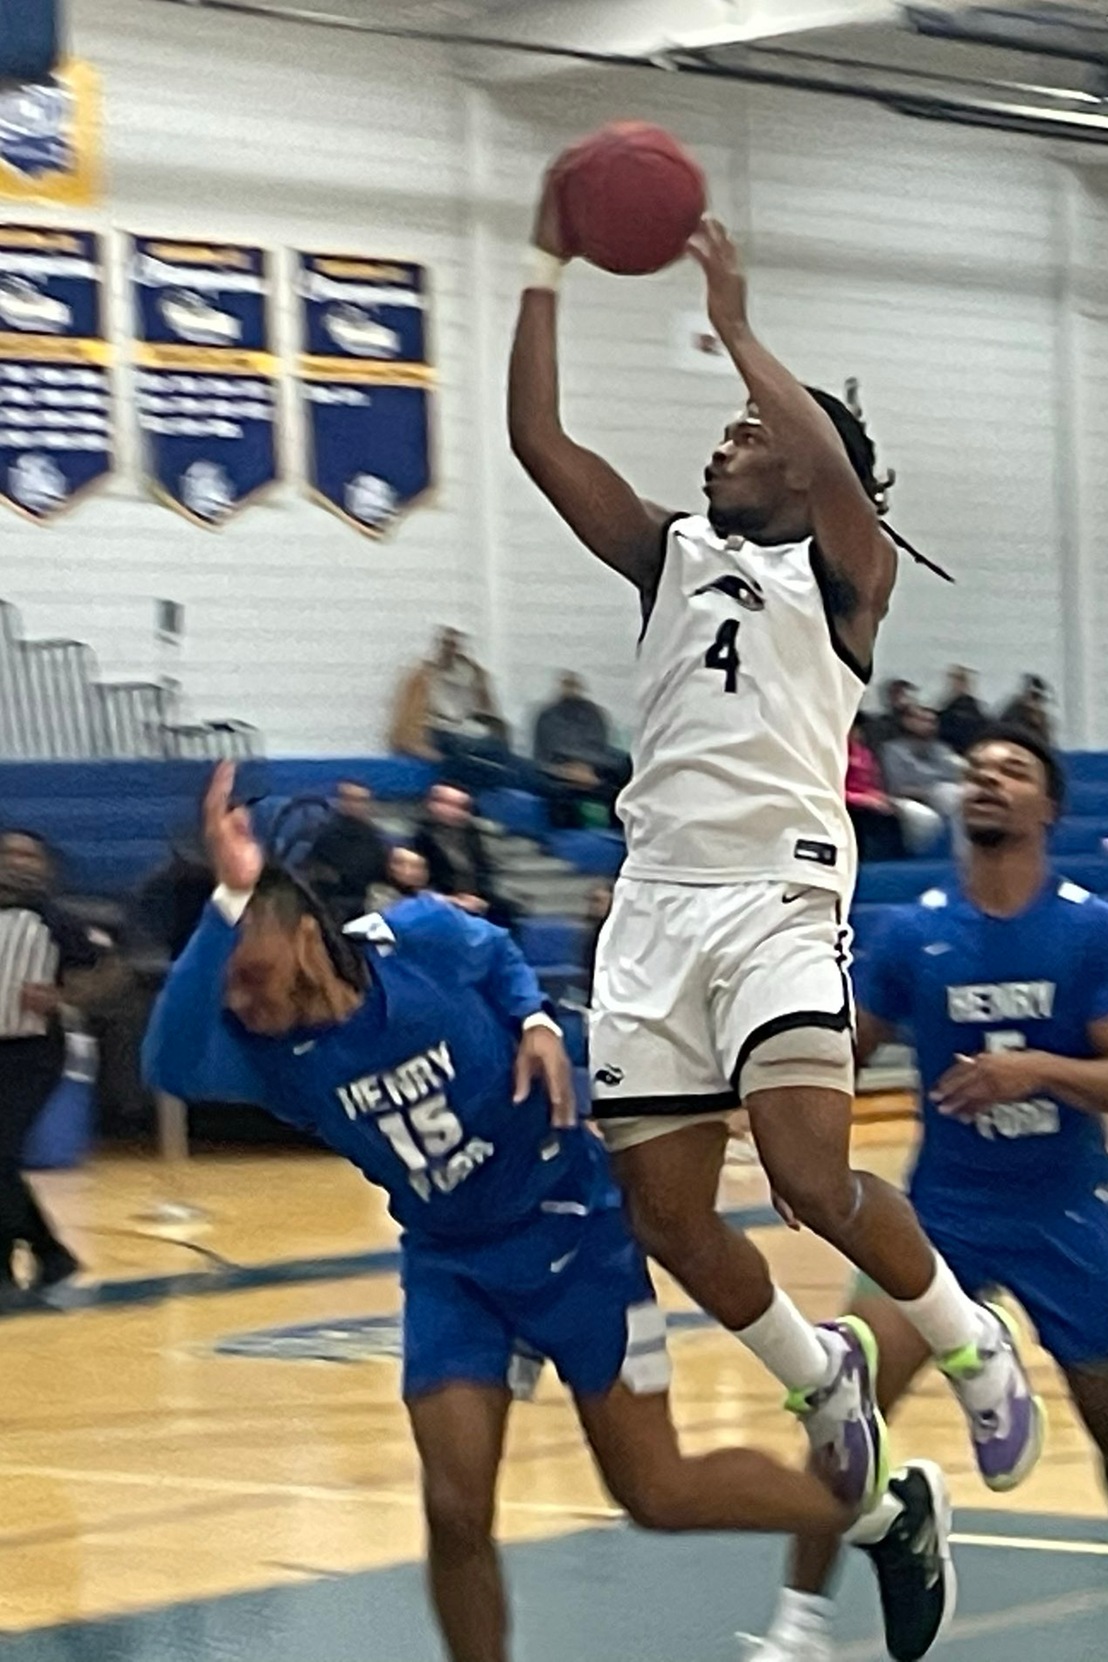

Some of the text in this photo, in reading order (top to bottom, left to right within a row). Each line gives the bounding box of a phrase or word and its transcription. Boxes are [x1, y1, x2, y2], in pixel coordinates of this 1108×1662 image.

[704, 618, 741, 693] 4
[337, 1040, 455, 1121] HENRY
[378, 1096, 463, 1171] 15
